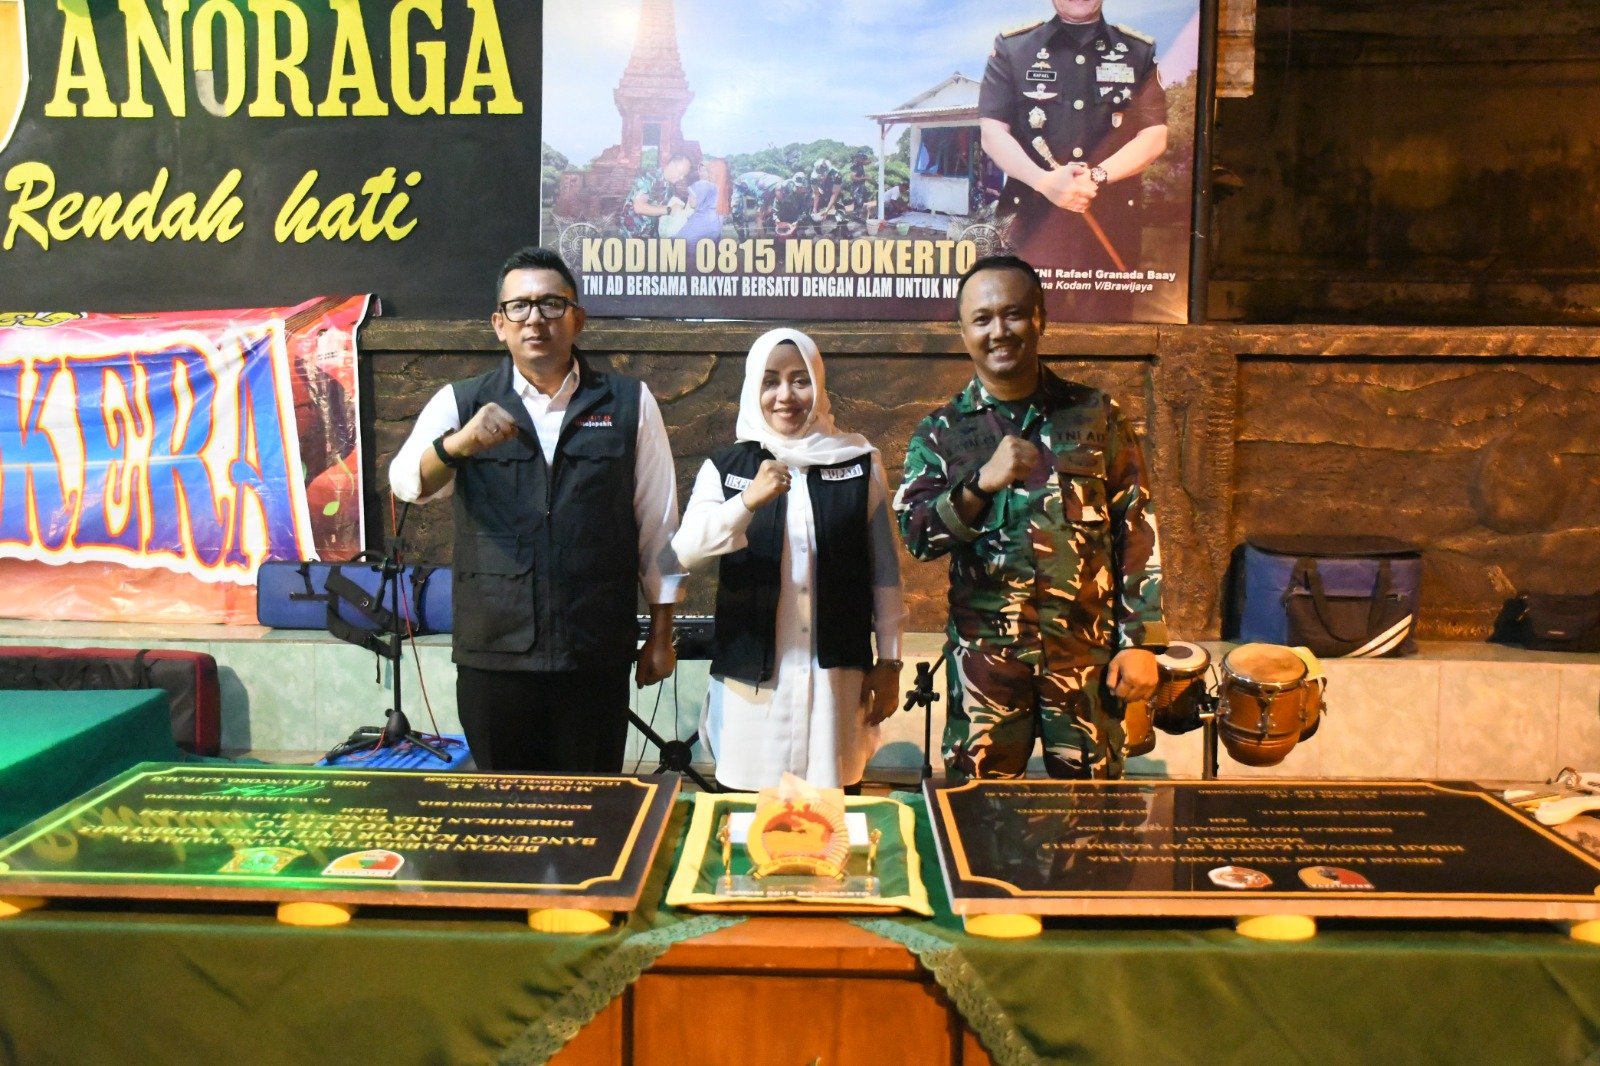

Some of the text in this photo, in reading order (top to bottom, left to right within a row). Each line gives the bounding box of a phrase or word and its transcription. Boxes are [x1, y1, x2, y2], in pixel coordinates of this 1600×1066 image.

[3, 161, 422, 250] Rendah hati
[582, 238, 977, 275] KODIM 0815 MOJOKERTO
[1055, 269, 1092, 279] Rafael
[1095, 270, 1145, 280] Granada
[1147, 270, 1176, 282] Baay
[582, 275, 603, 296] TNI
[606, 275, 624, 296] AD
[627, 275, 688, 296] BERSAMA
[691, 276, 739, 296] RAKYAT
[742, 276, 799, 297] BERSATU
[802, 276, 854, 298] DENGAN
[857, 277, 893, 298] ALAM
[896, 277, 939, 298] UNTUK
[1055, 281, 1092, 290] Kodam
[1094, 281, 1154, 293] V/Brawijaya
[296, 813, 388, 822] TANGGAL
[394, 816, 444, 824] PADA
[447, 818, 574, 827] DIRESMIKAN
[295, 830, 352, 840] UNIT
[358, 832, 459, 842] KANTOR
[462, 834, 598, 845] BANGUNAN
[287, 839, 357, 849] TUHAN
[364, 842, 449, 851] RAHMAT
[454, 844, 540, 853] DENGAN
